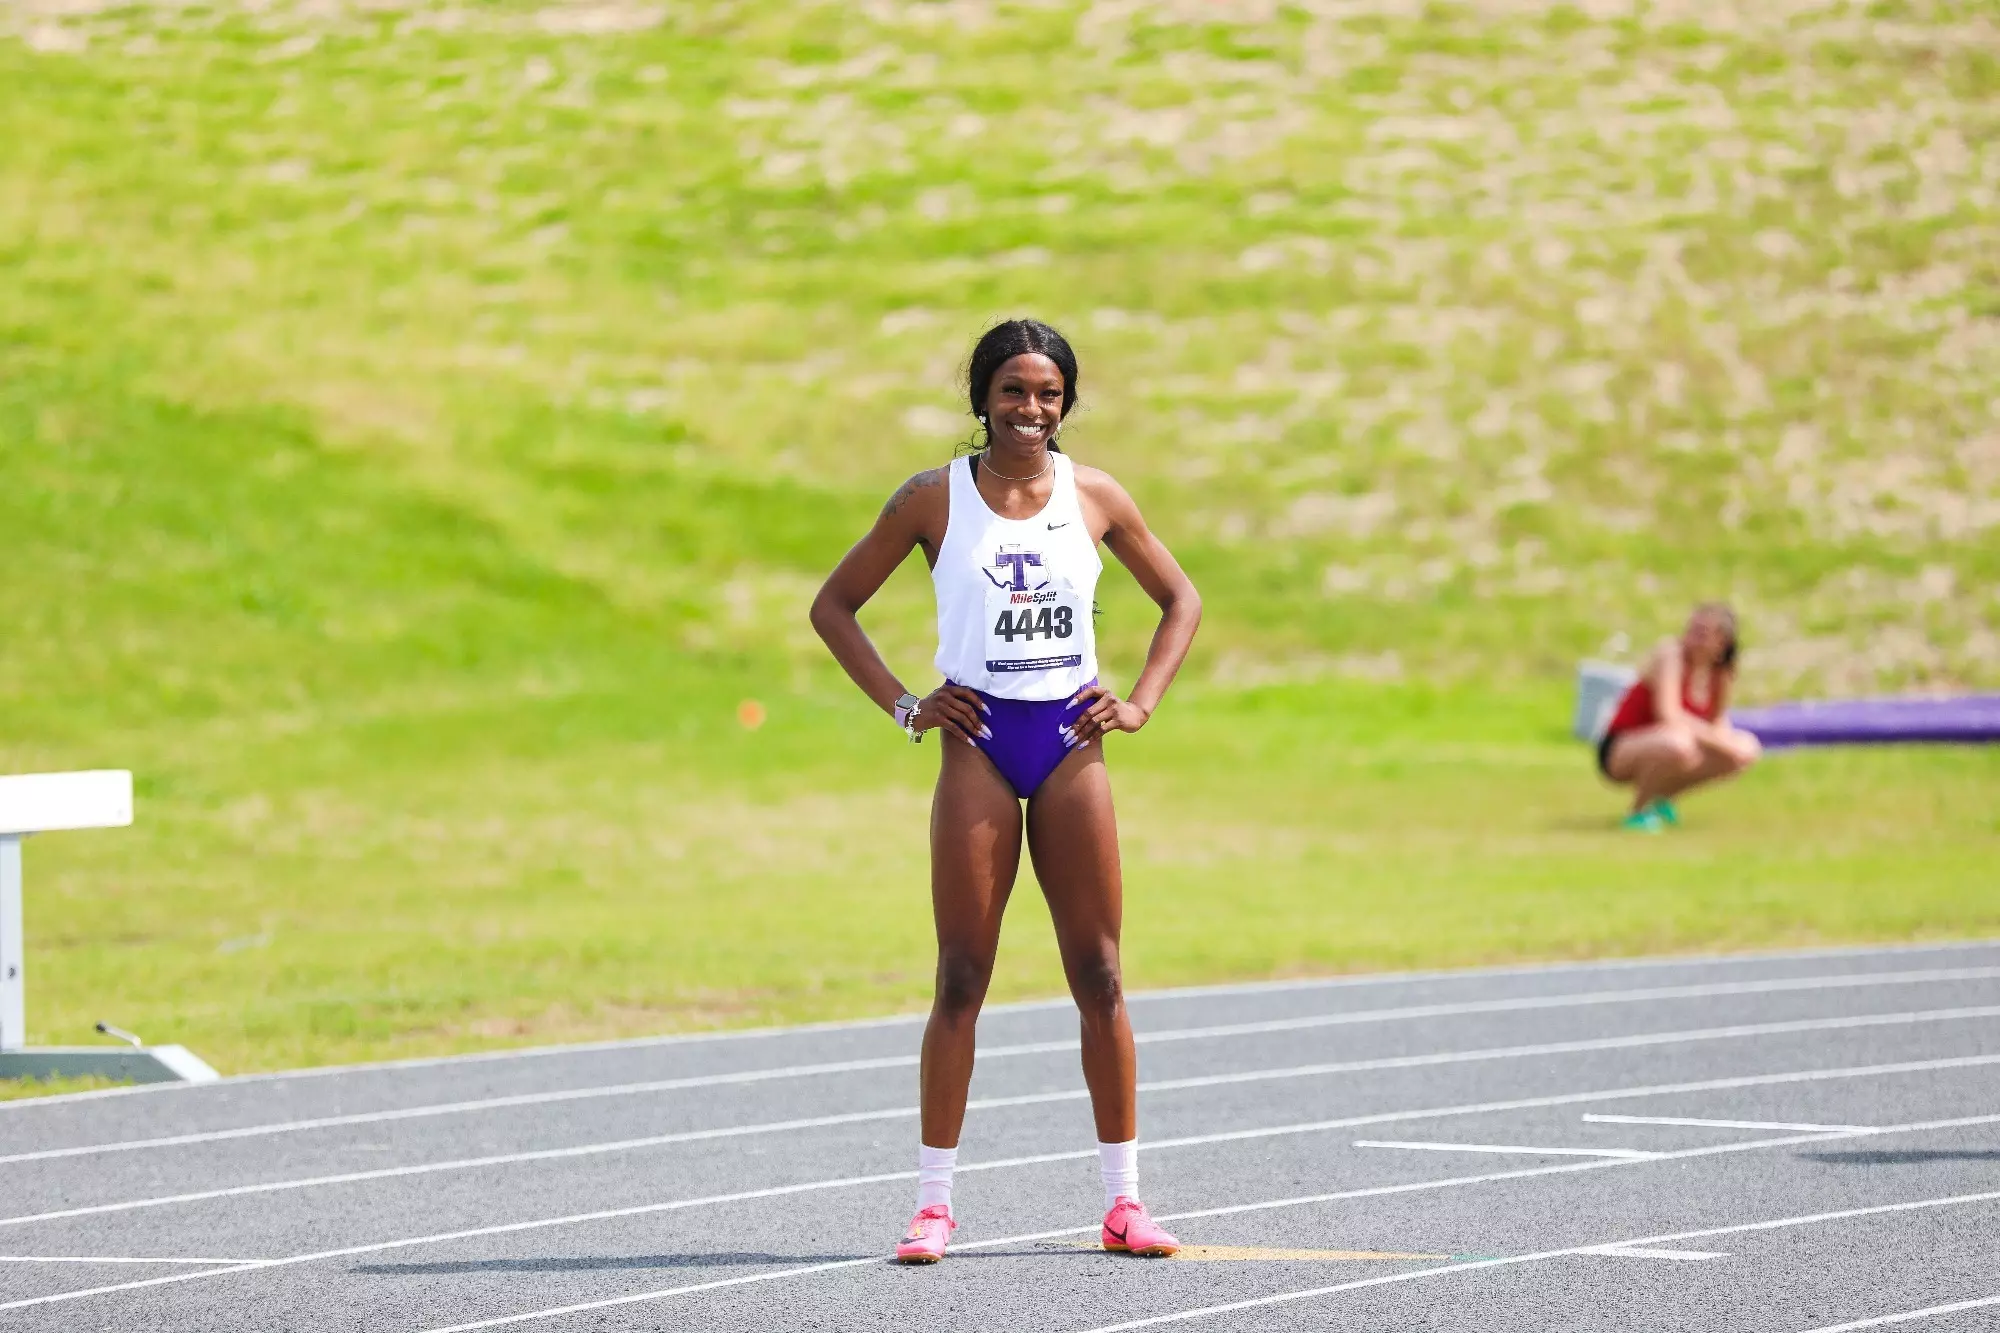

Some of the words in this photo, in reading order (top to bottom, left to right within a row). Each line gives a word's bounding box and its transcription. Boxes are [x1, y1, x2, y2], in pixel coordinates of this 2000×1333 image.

[996, 552, 1043, 592] T
[1010, 591, 1058, 604] MileSplit
[994, 606, 1073, 643] 4443
